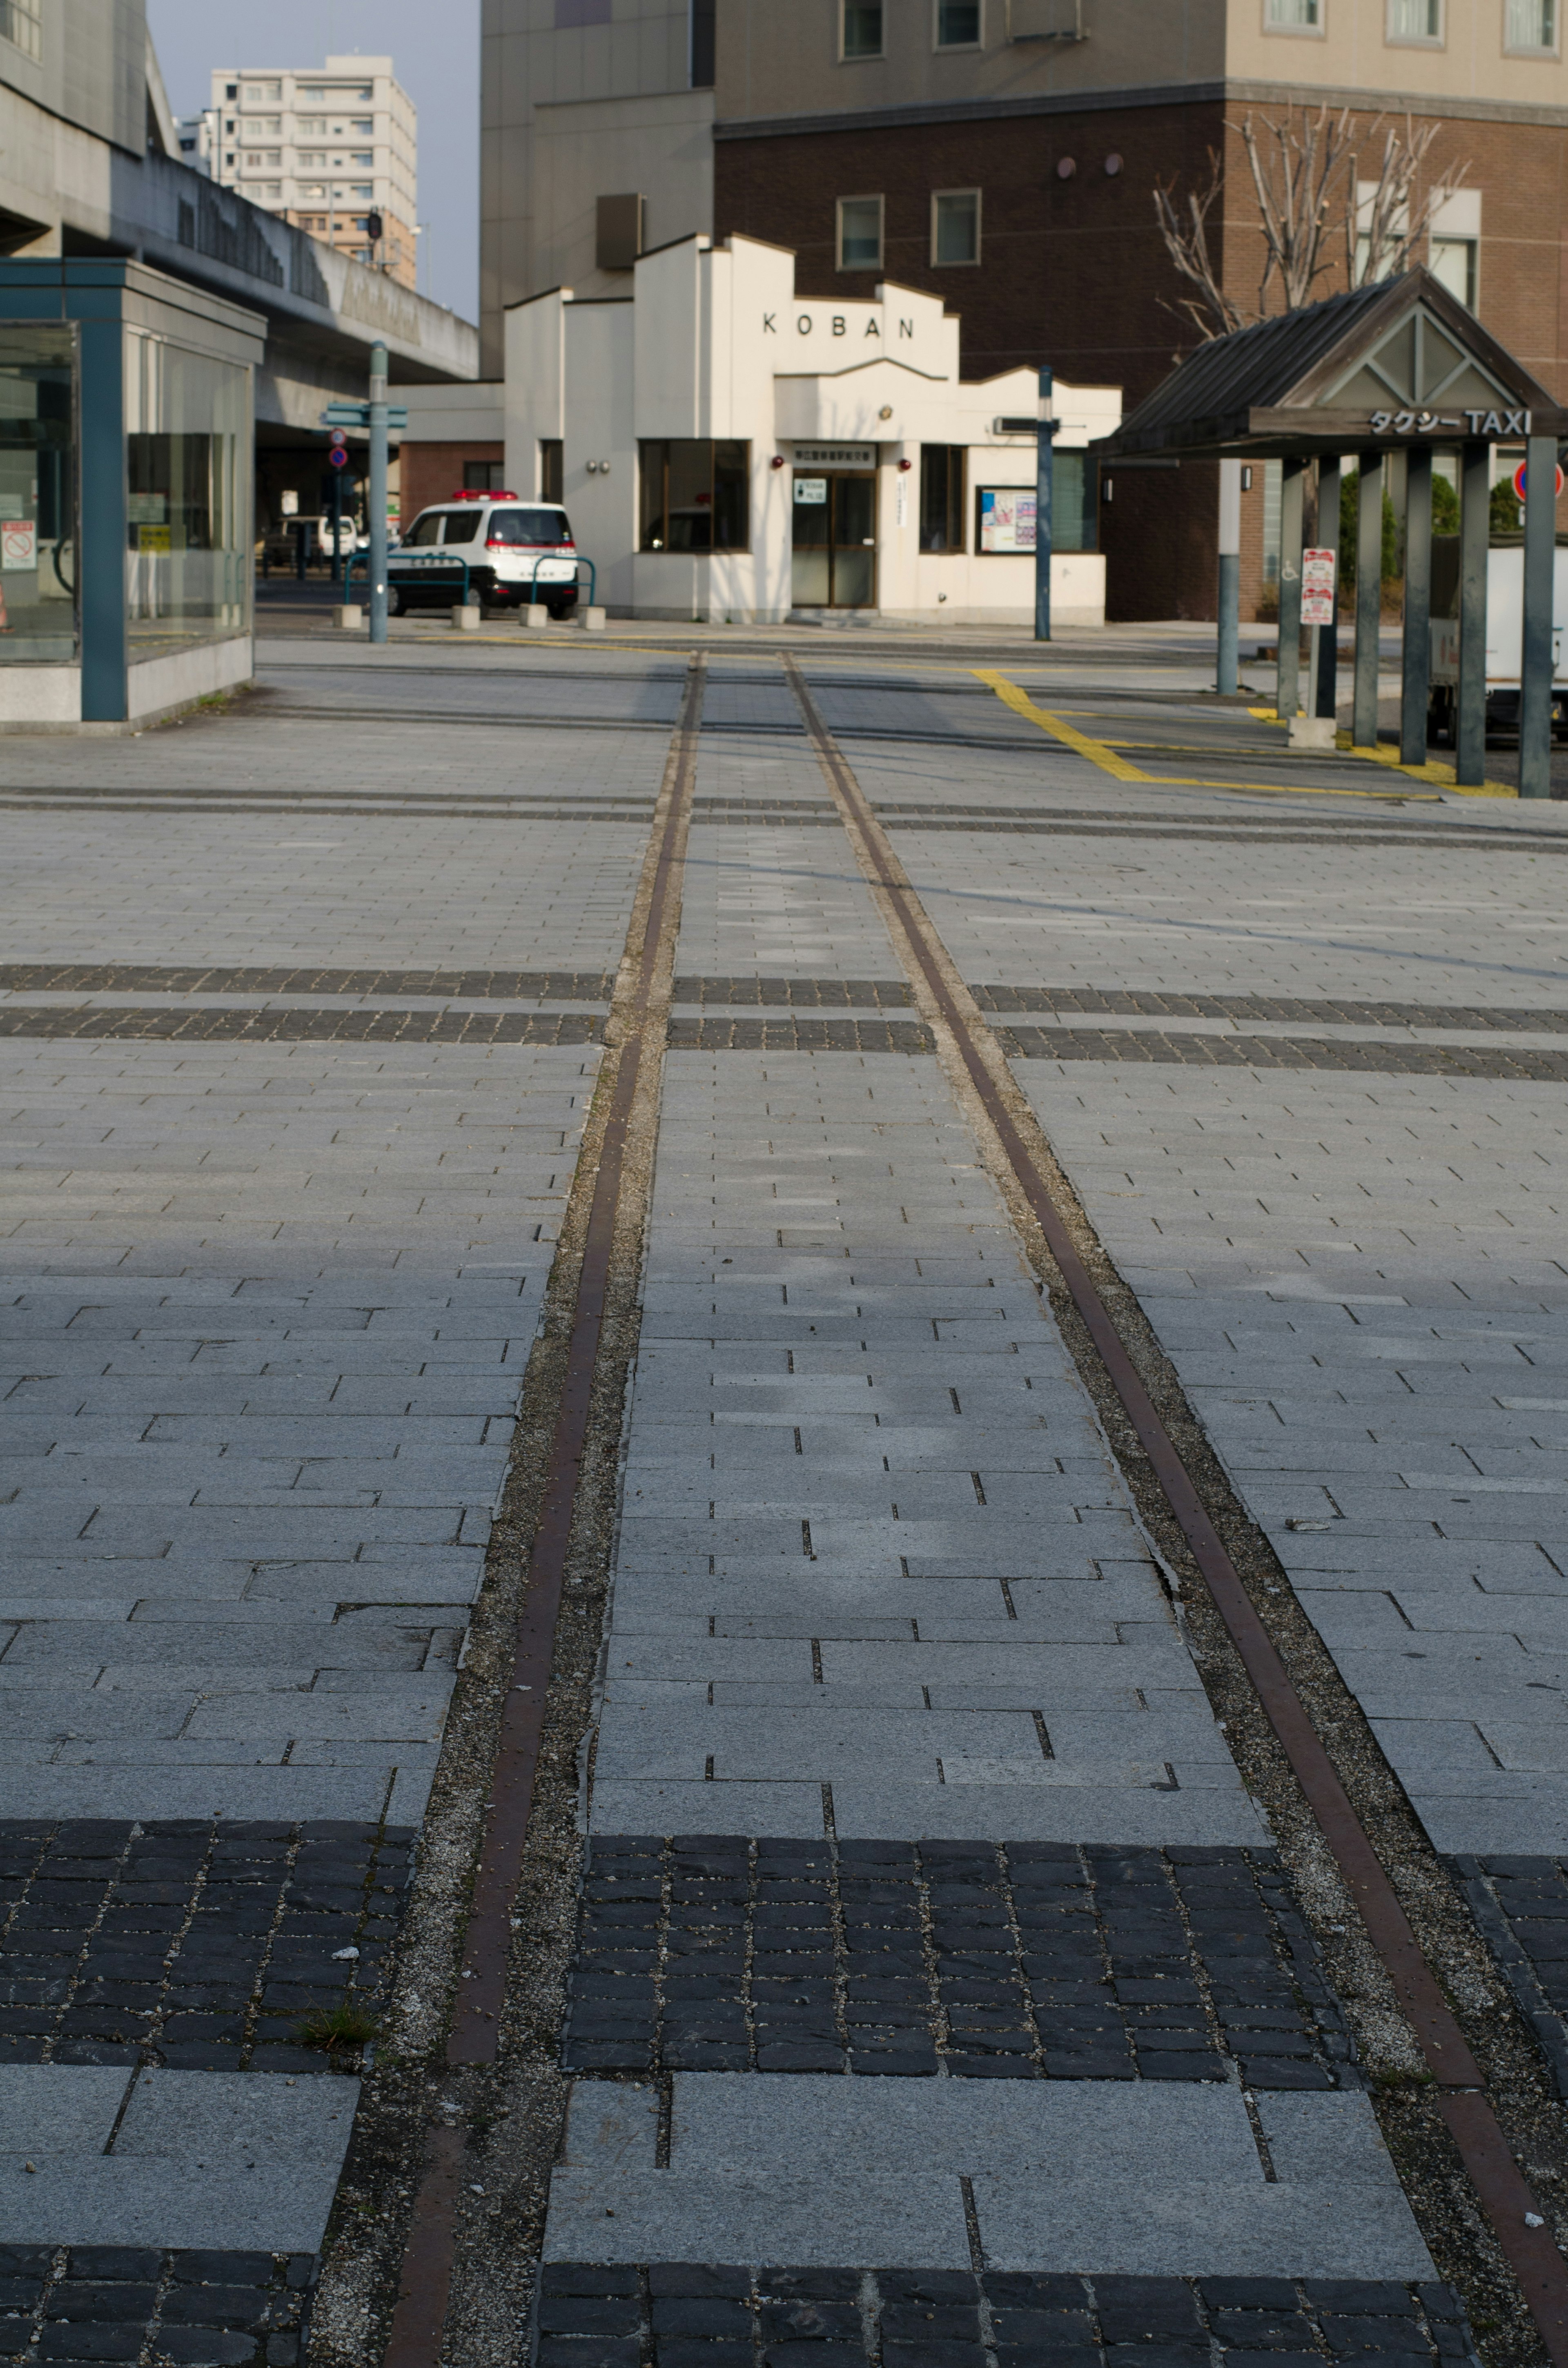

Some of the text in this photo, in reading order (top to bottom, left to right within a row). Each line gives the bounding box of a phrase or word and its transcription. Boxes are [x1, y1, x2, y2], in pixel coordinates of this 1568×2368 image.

[763, 312, 913, 338] KOBAN
[1370, 410, 1532, 435] タクシー TAXI
